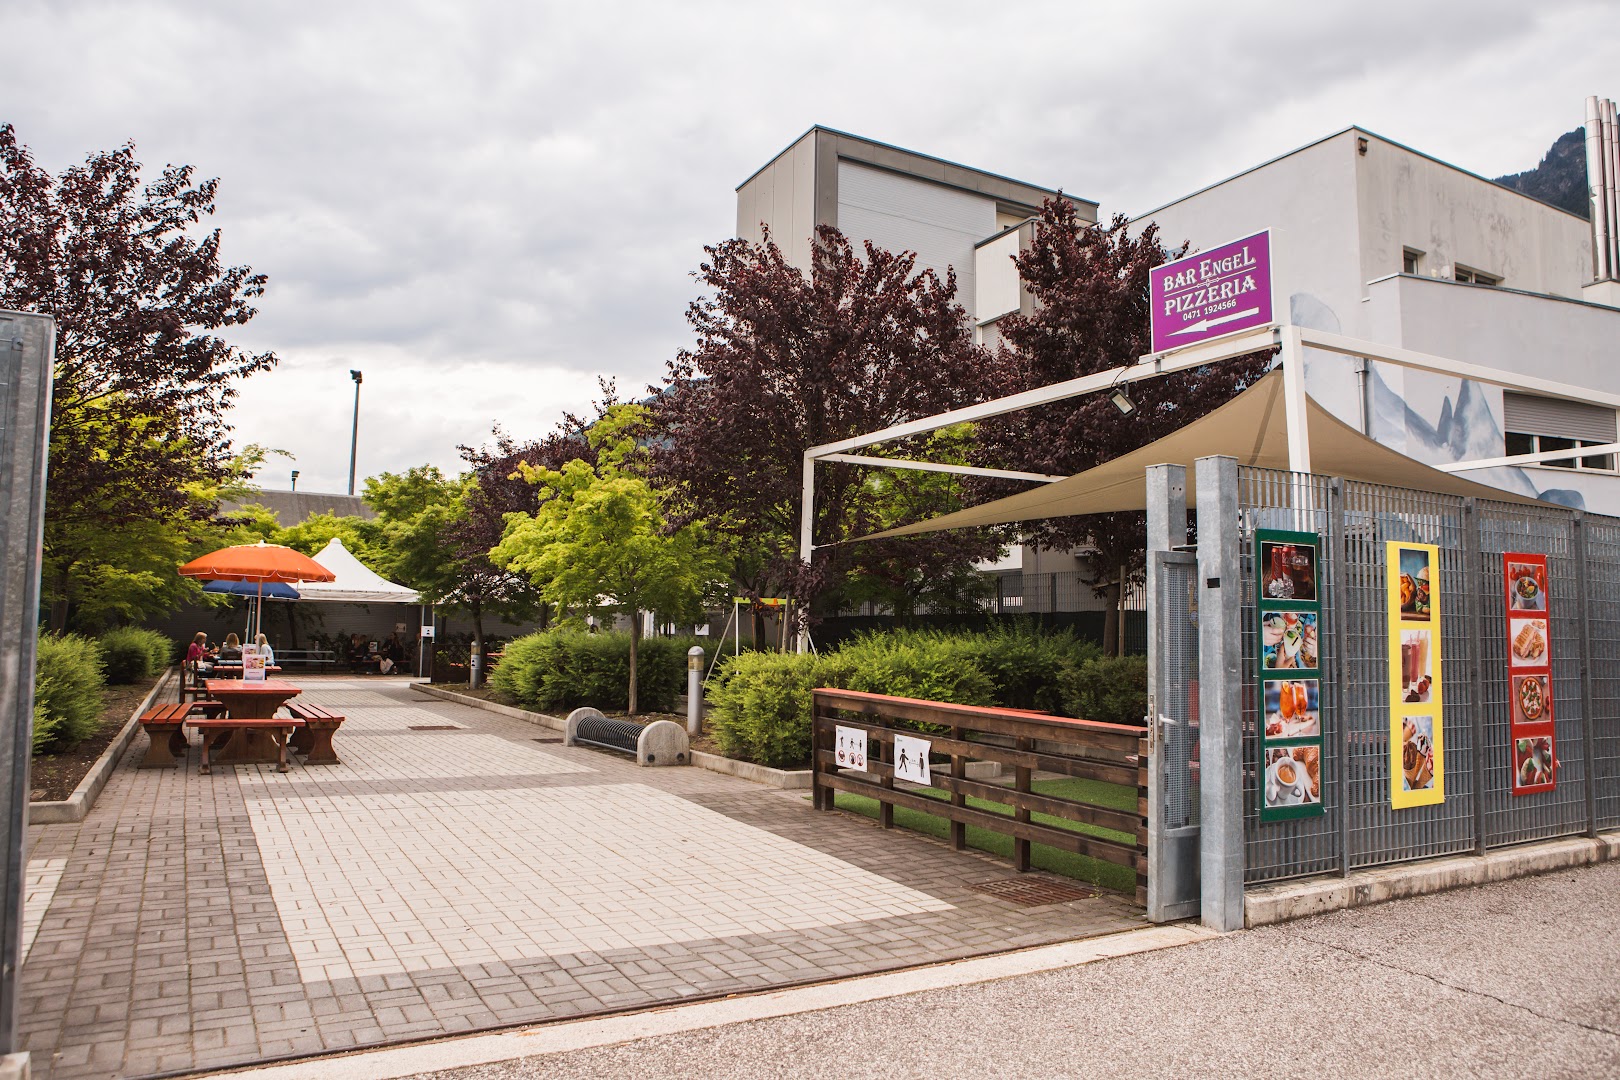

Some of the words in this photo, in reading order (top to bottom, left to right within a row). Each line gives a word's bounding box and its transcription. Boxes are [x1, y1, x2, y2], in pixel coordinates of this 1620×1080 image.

[1164, 269, 1197, 292] BAR
[1199, 246, 1256, 280] ENGEL
[1164, 275, 1257, 316] PIZZERIA
[1183, 310, 1201, 321] 0471
[1204, 299, 1237, 315] 1924566
